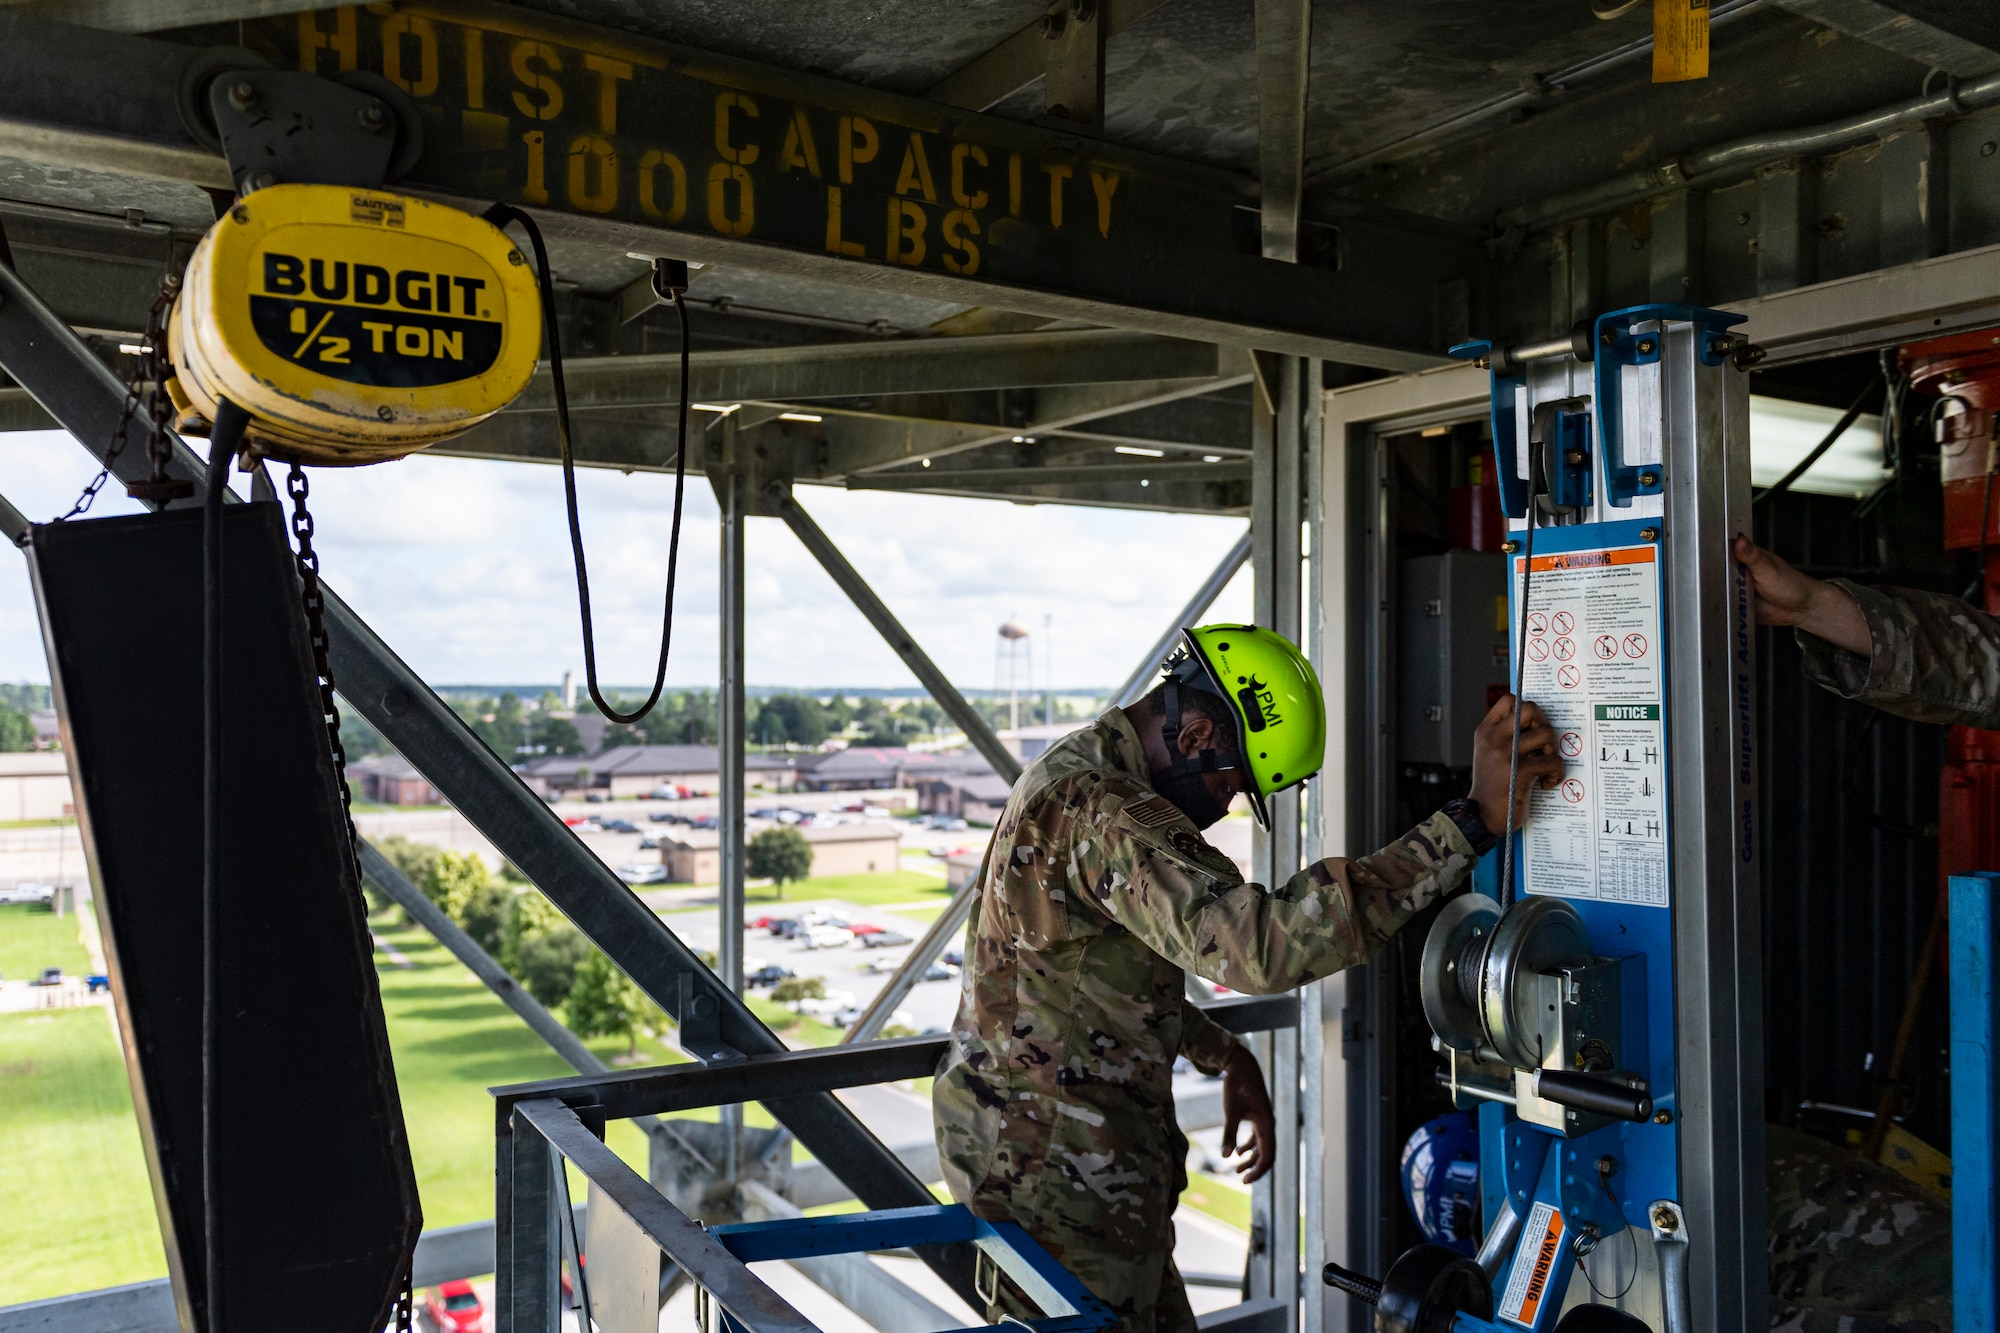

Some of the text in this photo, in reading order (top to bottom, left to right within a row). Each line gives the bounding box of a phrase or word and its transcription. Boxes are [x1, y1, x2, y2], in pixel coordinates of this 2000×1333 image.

[297, 8, 1121, 239] HOIST CAPACITY
[353, 197, 403, 213] CAUTION
[521, 130, 982, 276] 1000 LBS
[361, 321, 464, 361] TON
[1565, 552, 1612, 568] WARNING
[1257, 690, 1284, 728] PMI
[1606, 706, 1648, 719] NOTICE
[1736, 533, 1752, 863] Genie Superlift Advanta
[1440, 1196, 1454, 1229] PMI
[1528, 1242, 1556, 1302] WARNING
